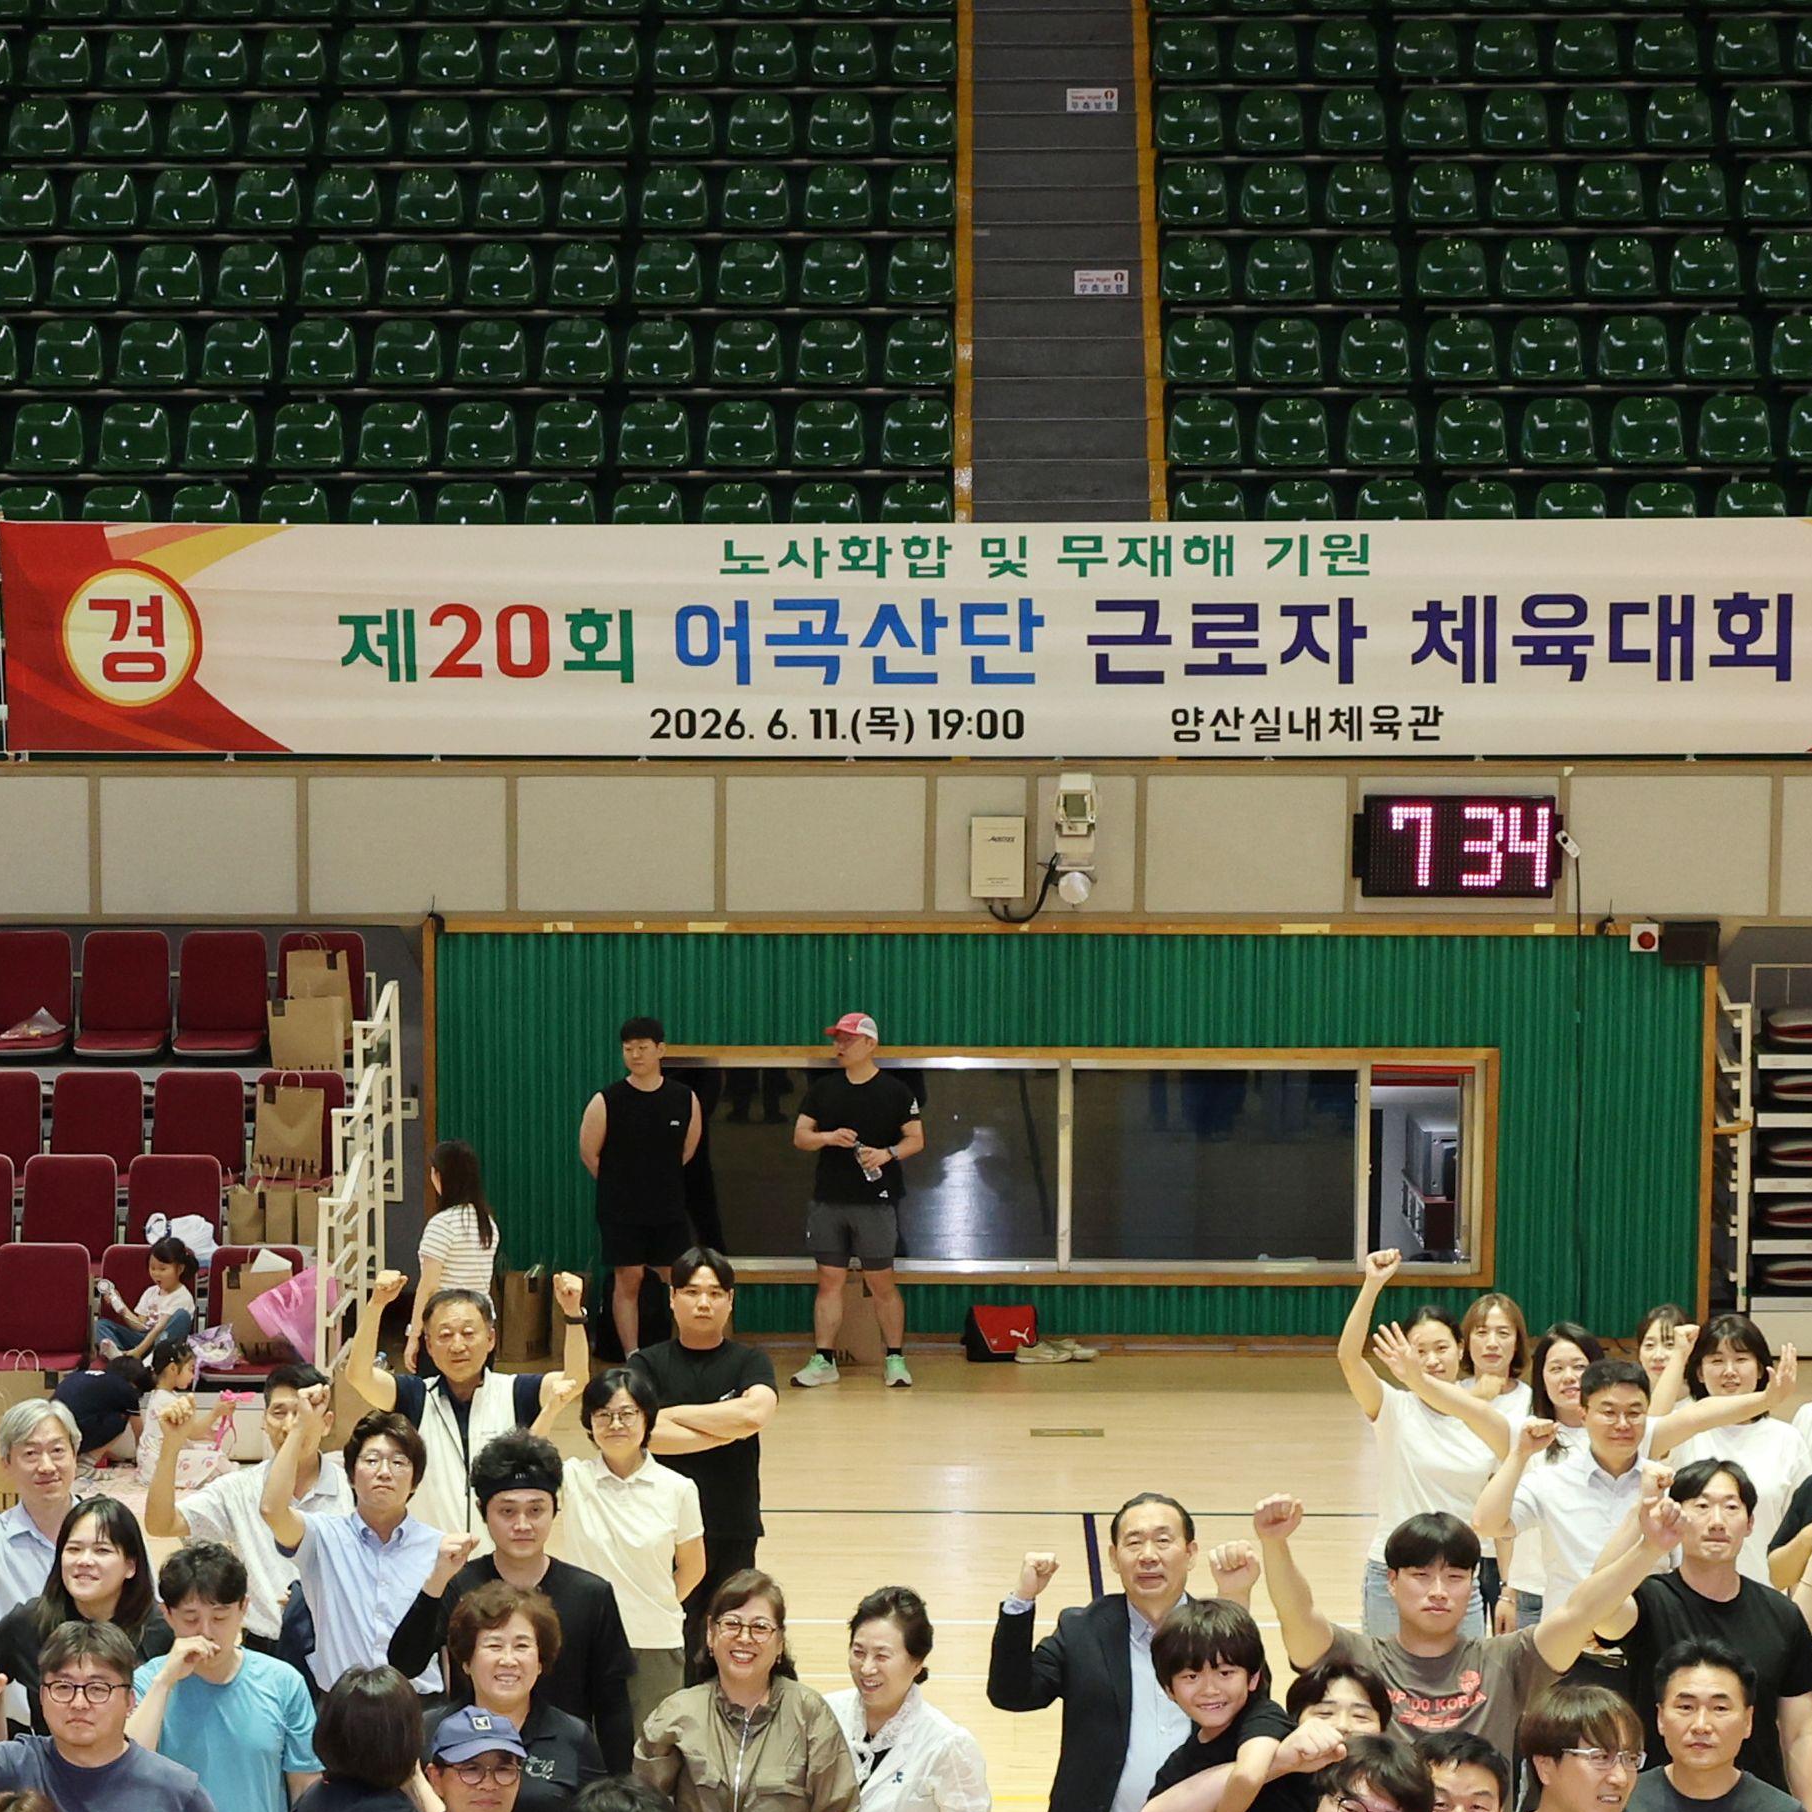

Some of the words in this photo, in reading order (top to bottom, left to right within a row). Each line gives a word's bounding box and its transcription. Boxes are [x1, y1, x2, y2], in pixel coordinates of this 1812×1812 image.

[720, 535, 953, 578] 노사화합
[981, 536, 1028, 578] 및
[1056, 534, 1235, 577] 무재해
[1266, 533, 1372, 577] 기원
[88, 598, 169, 683] 경
[338, 602, 635, 684] 제20회
[675, 597, 1045, 685] 어곡산단
[1086, 597, 1368, 685] 근로자
[1410, 592, 1794, 685] 체육대회
[649, 706, 756, 741] 2026.
[767, 707, 798, 741] 6.
[927, 707, 1026, 741] 19:00
[1171, 704, 1445, 743] 양산실내체육관
[255, 1152, 316, 1174] WITH
